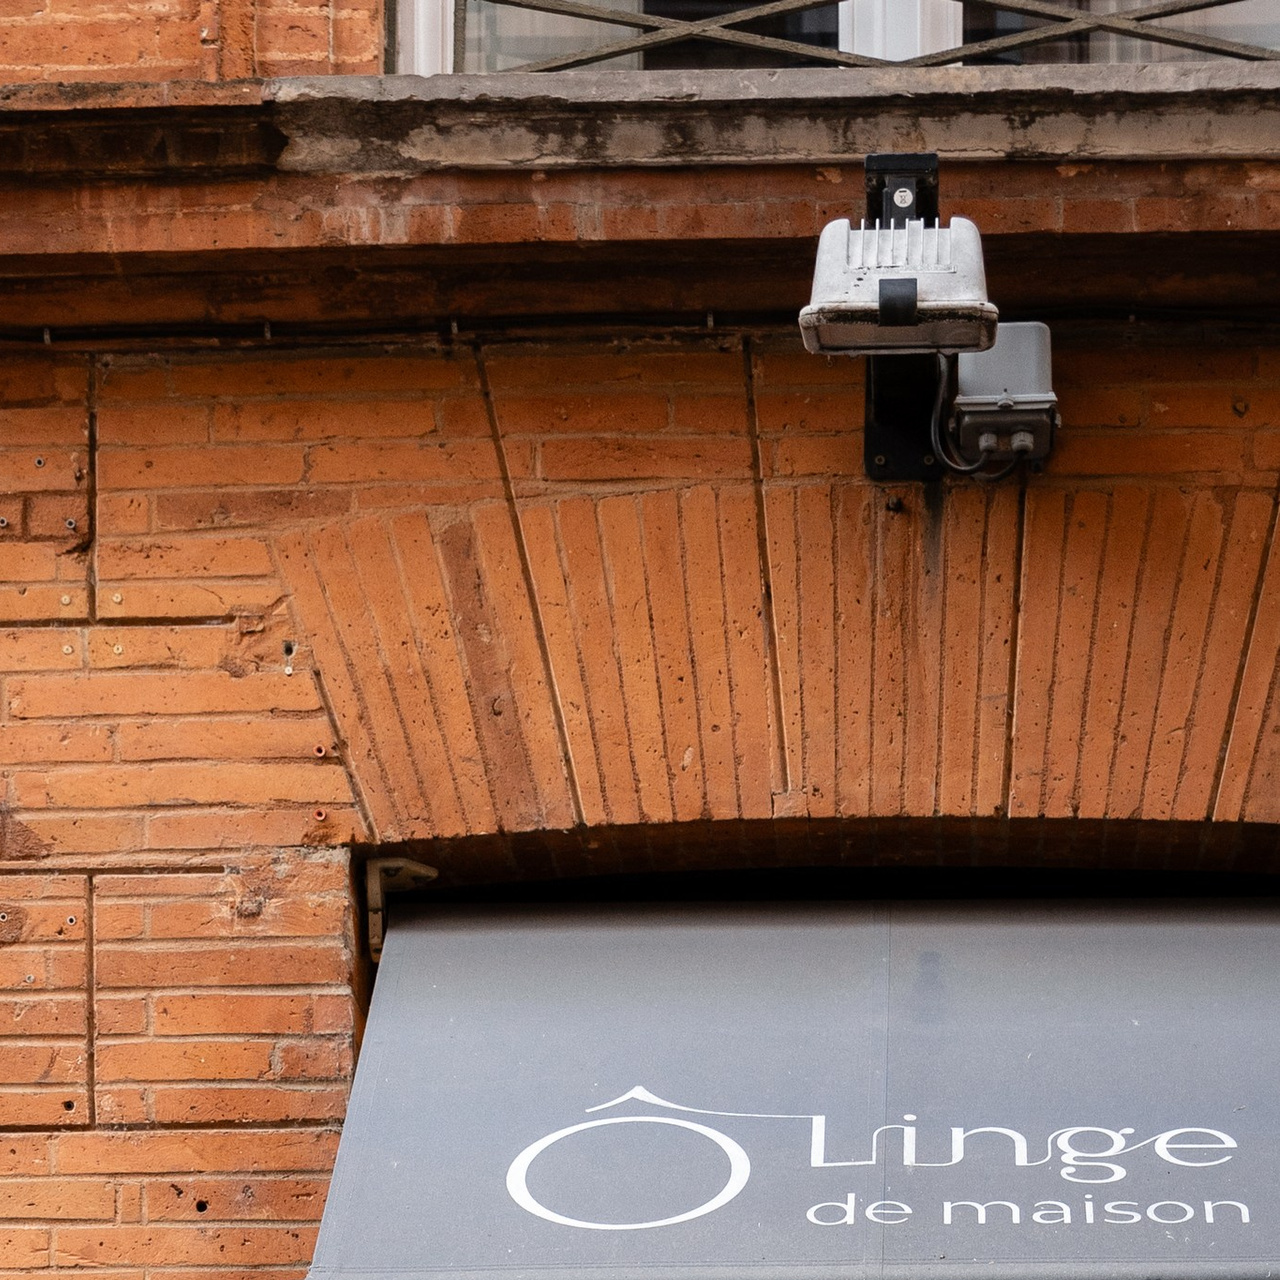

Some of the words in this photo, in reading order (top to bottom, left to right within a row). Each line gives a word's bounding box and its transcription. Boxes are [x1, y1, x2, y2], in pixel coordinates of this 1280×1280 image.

[811, 1114, 1239, 1184] Linge
[805, 1192, 913, 1226] de
[942, 1194, 1251, 1226] maison
